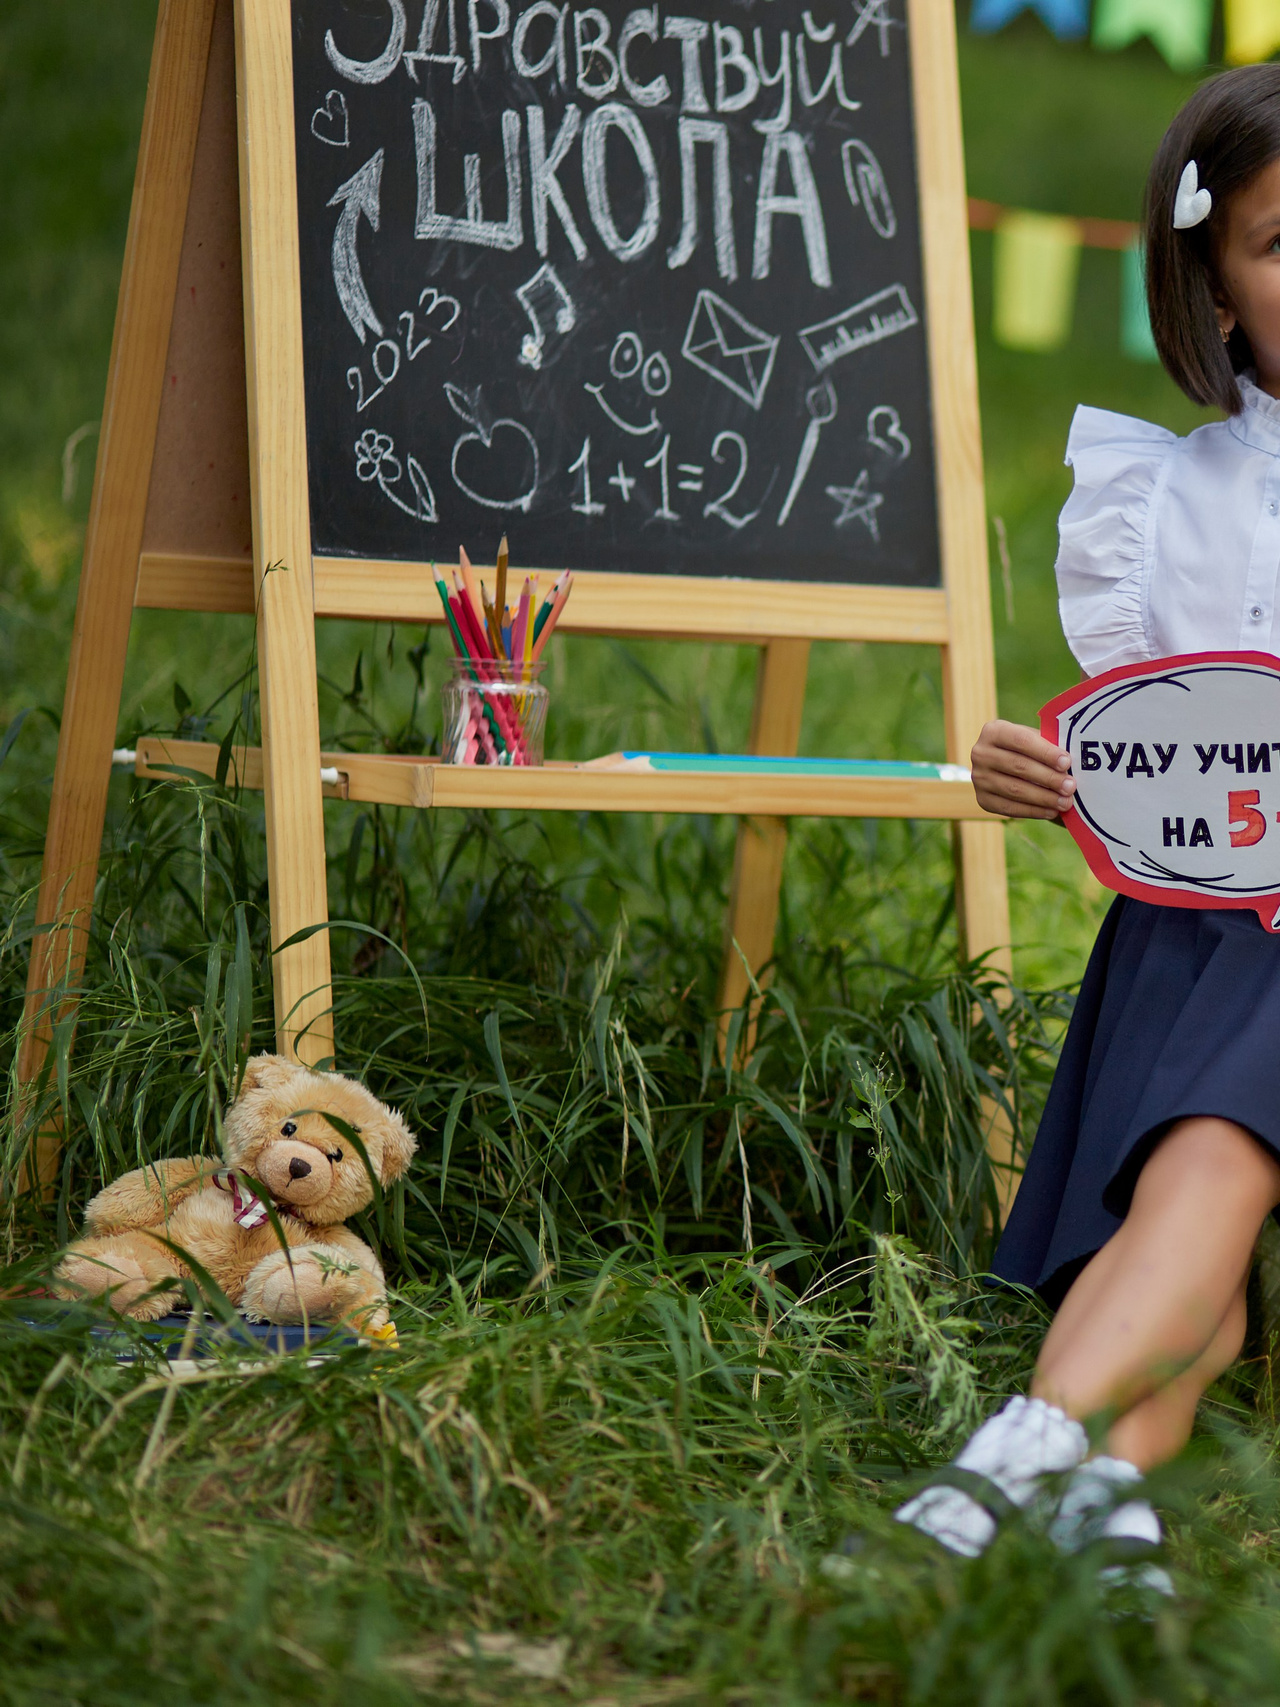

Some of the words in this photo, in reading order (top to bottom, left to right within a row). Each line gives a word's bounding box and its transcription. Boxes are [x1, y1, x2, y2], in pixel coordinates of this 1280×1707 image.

[411, 97, 834, 288] ШКОЛА
[346, 287, 461, 413] 2023
[1080, 741, 1178, 778] БУДУ
[1162, 817, 1214, 848] НА
